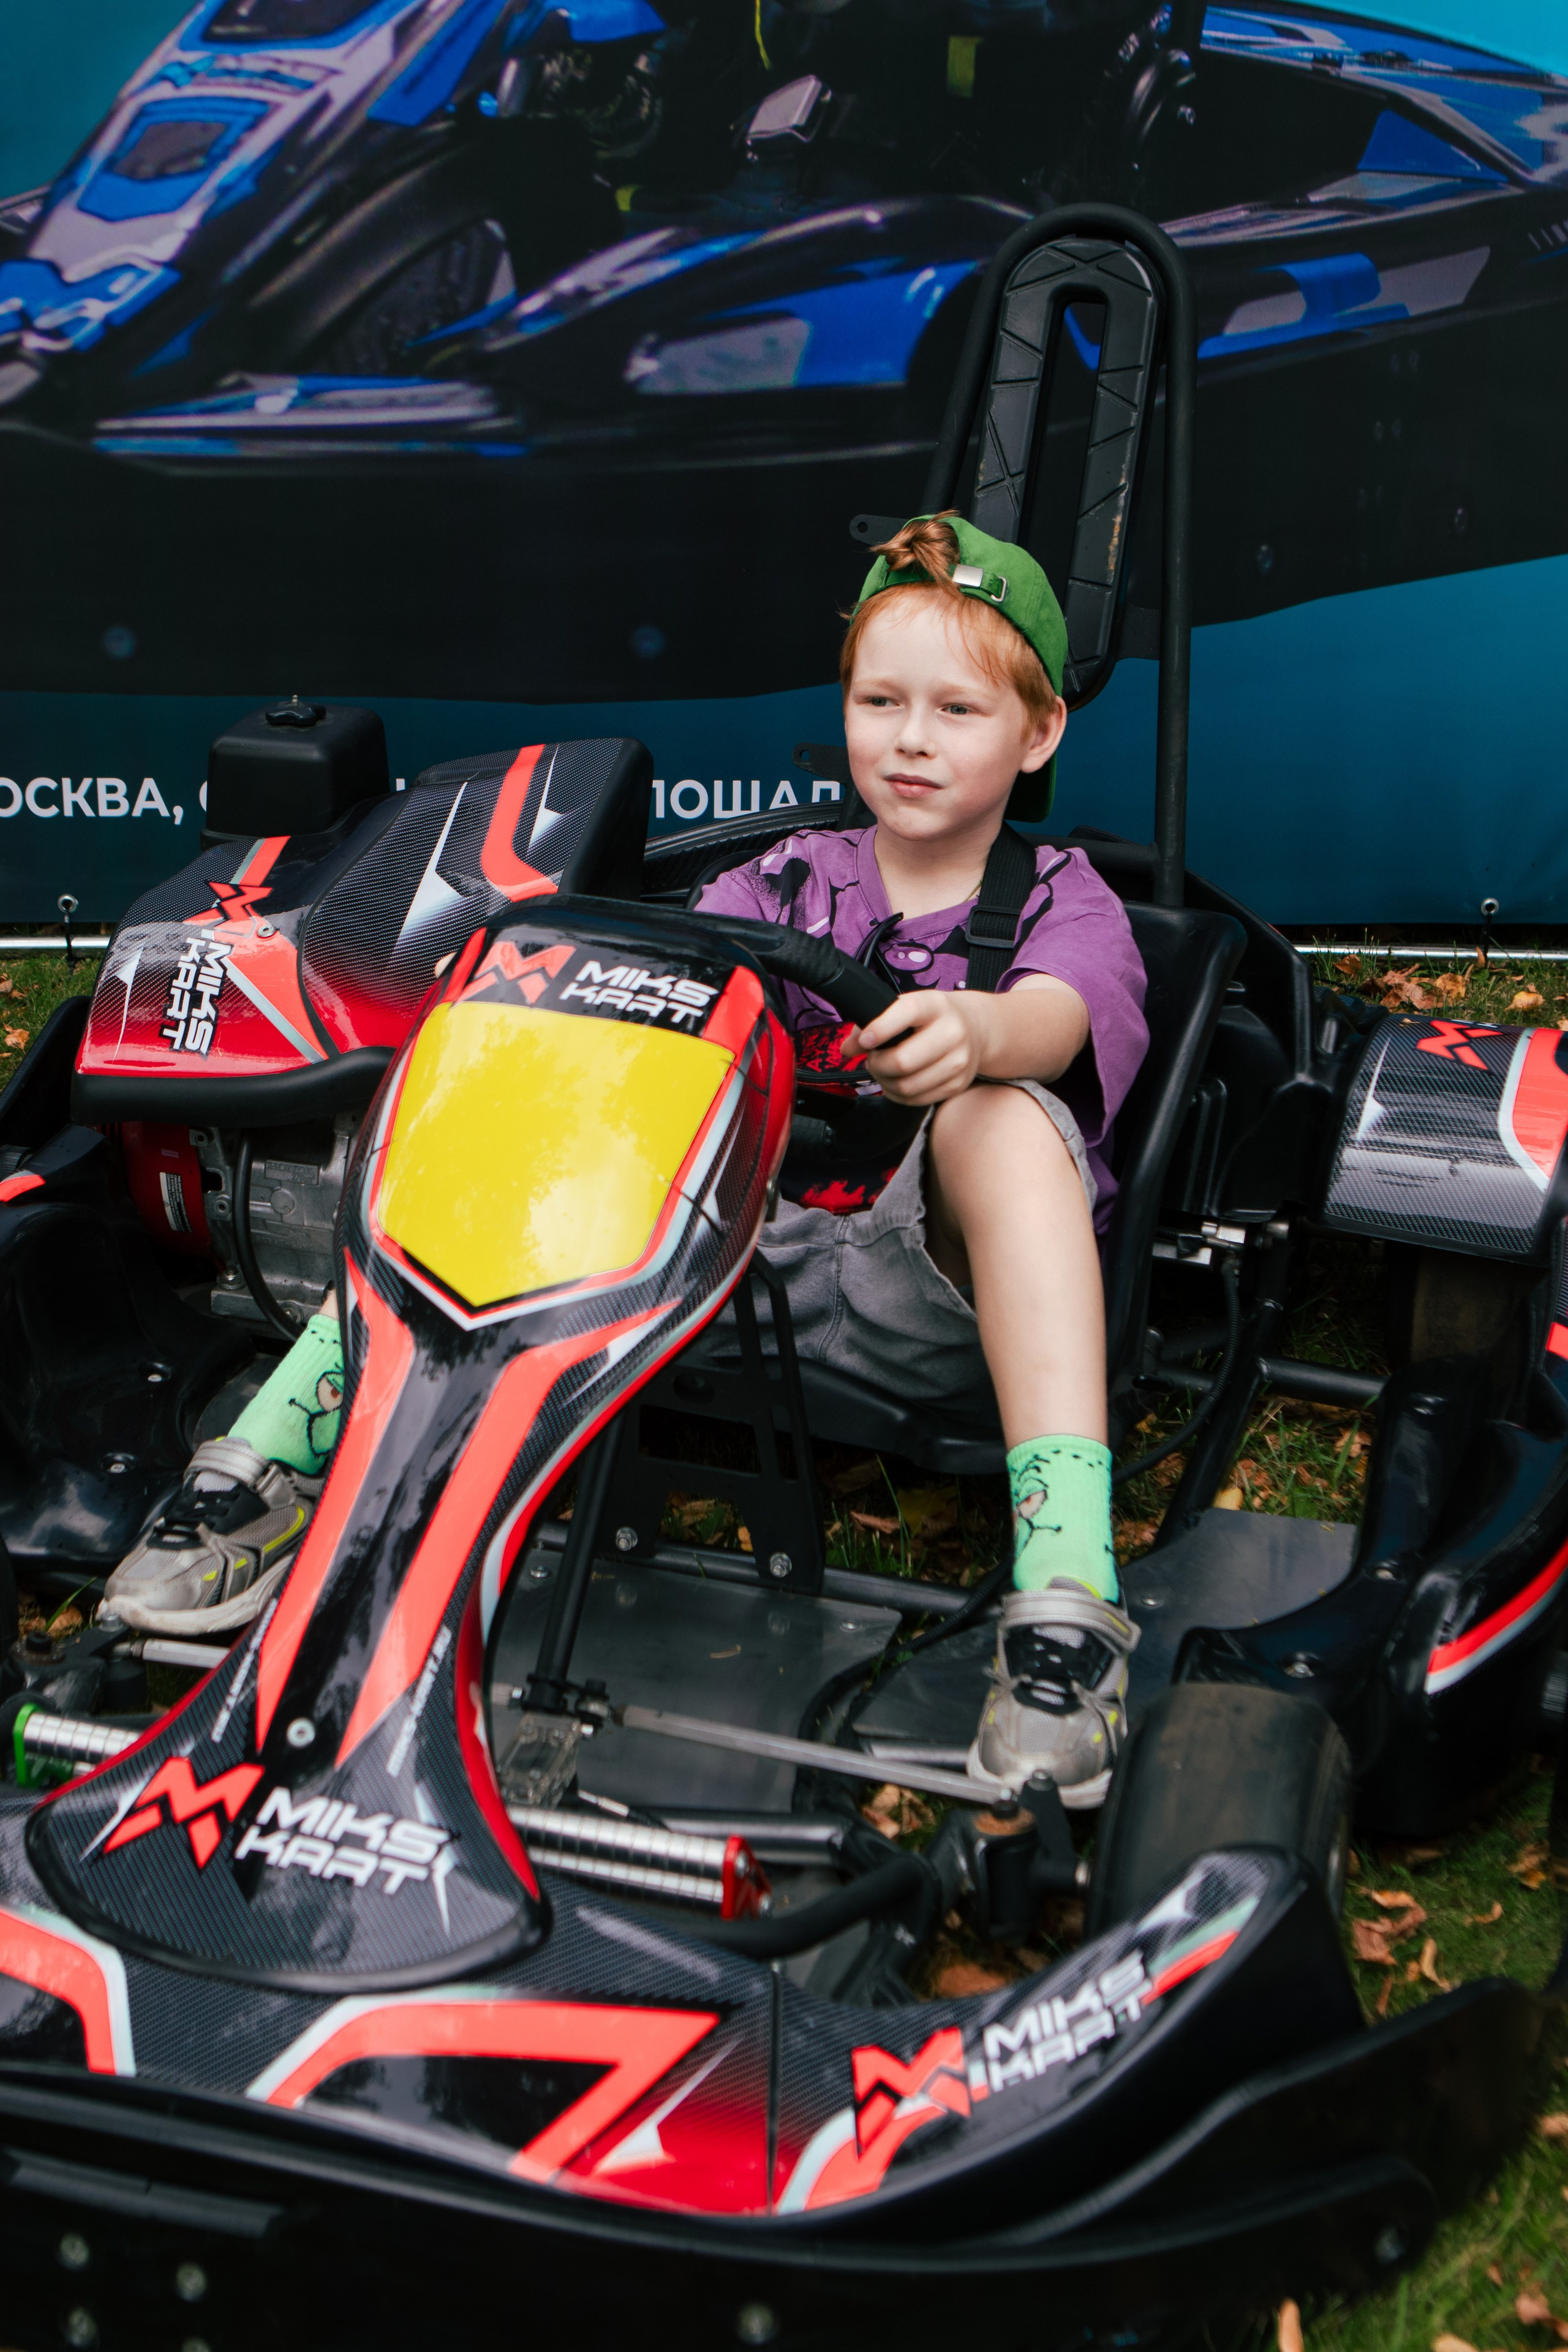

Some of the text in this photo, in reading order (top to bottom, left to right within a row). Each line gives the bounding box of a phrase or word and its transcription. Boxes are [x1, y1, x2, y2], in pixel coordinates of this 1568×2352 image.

[0, 777, 184, 826] ОСКВА,
[162, 937, 206, 1050] KART
[185, 941, 232, 1055] MIKS
[559, 982, 704, 1023] KART
[576, 960, 719, 1007] MIKS
[235, 1826, 429, 1894] KART
[257, 1787, 450, 1863] MIKS
[984, 1949, 1146, 2059] MIKS
[987, 1978, 1153, 2092] KART
